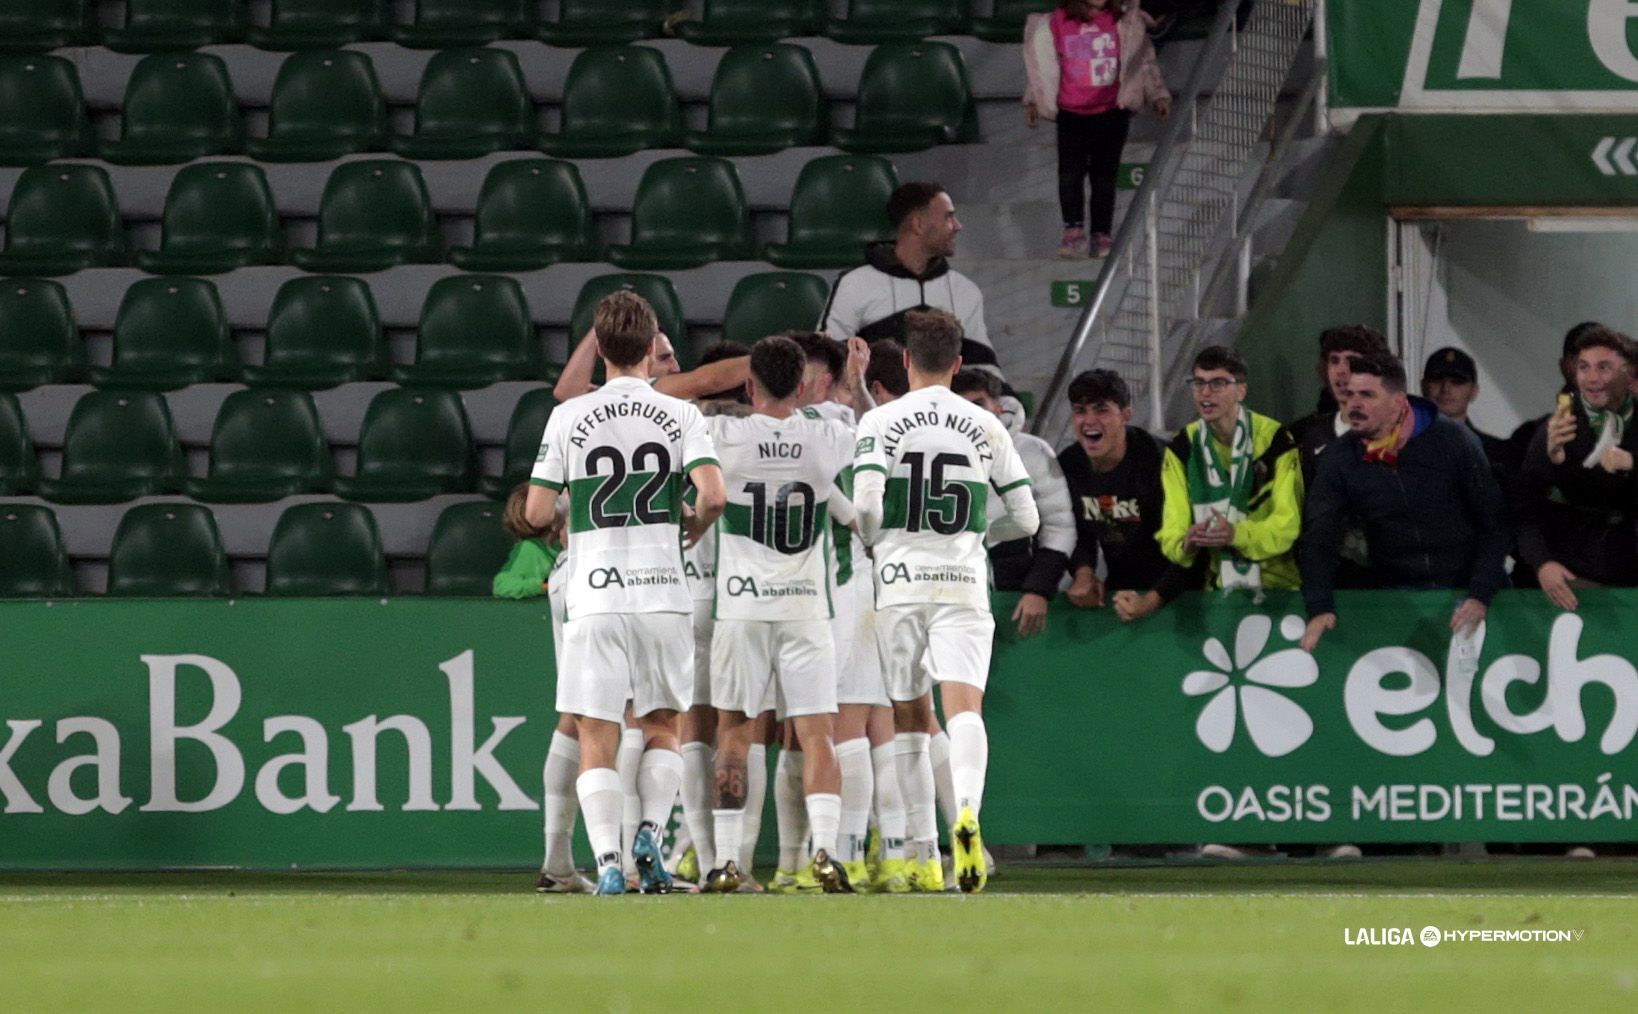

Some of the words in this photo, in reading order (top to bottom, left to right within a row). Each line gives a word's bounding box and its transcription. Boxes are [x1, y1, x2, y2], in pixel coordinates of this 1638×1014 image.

[1130, 167, 1144, 186] 6
[1066, 284, 1081, 304] 5
[570, 402, 682, 449] AFFENGRUBER
[945, 413, 993, 463] NÚÑEZ
[758, 442, 803, 459] NICO
[585, 441, 671, 529] 22
[900, 451, 972, 536] 15
[742, 481, 816, 556] 10
[627, 575, 682, 586] abatible
[914, 572, 977, 584] abatibles
[1197, 785, 1332, 822] OASIS
